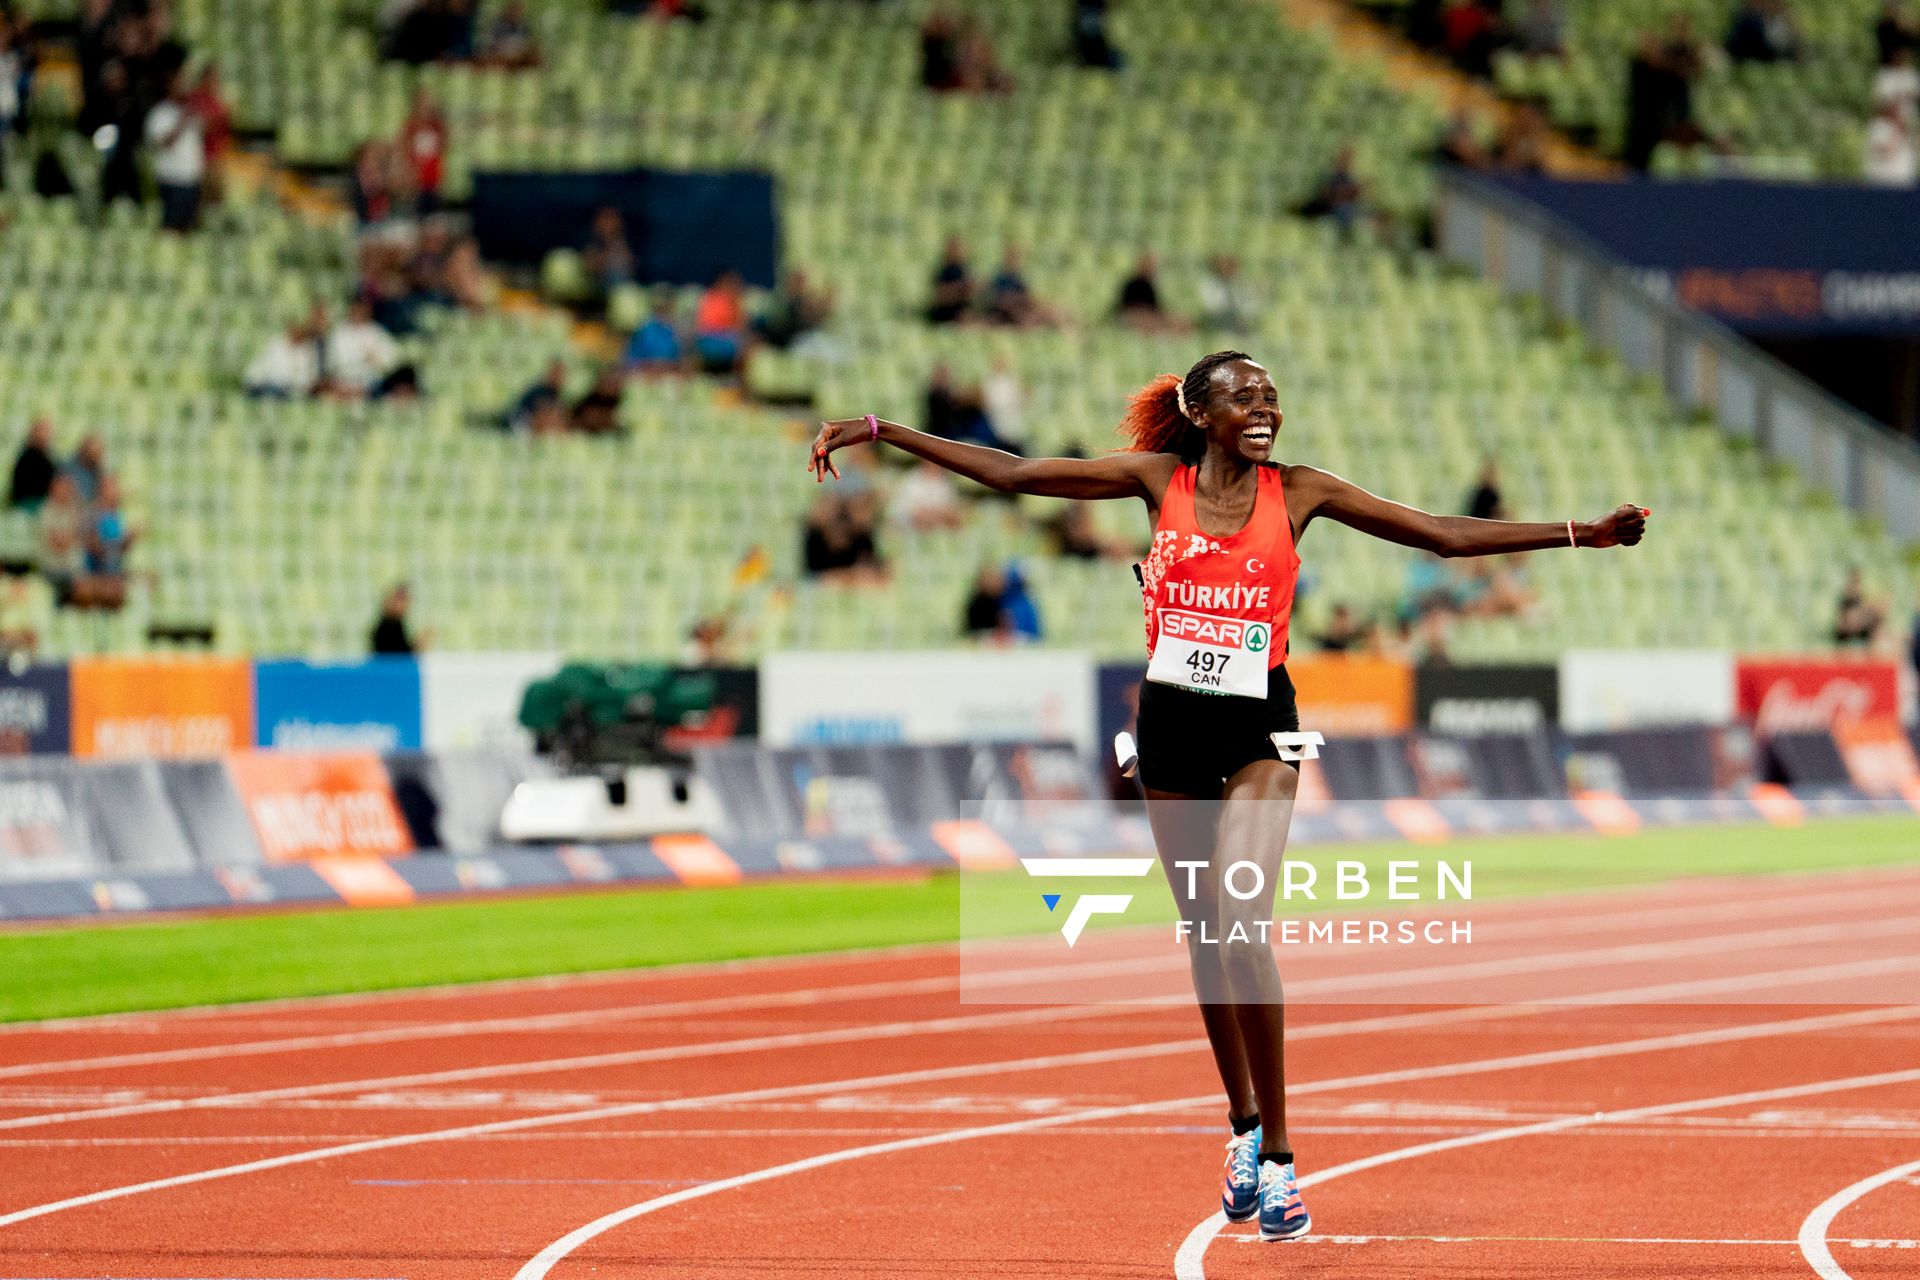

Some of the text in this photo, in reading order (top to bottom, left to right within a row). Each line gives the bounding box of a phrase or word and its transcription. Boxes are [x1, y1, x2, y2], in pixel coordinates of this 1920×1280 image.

[1165, 579, 1271, 610] TÜRKİYE
[1164, 614, 1242, 646] SPAR
[1186, 649, 1231, 674] 497
[1191, 672, 1221, 687] CAN
